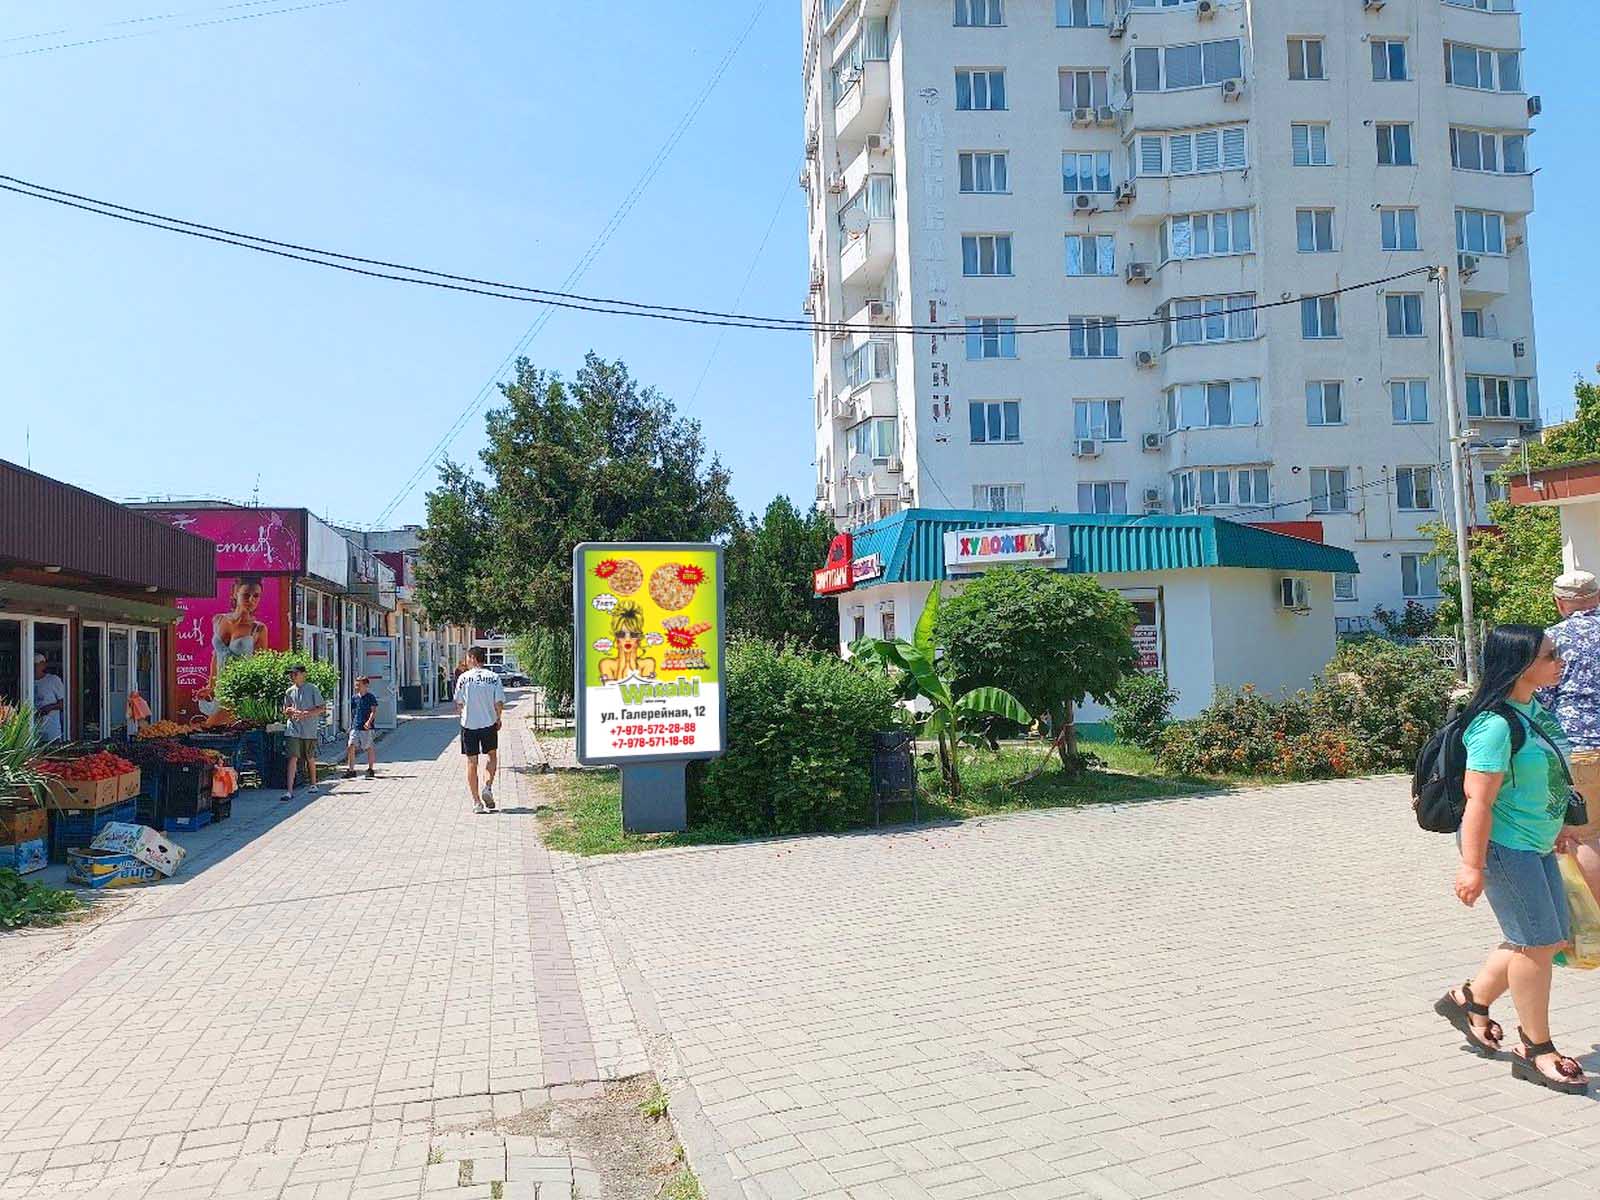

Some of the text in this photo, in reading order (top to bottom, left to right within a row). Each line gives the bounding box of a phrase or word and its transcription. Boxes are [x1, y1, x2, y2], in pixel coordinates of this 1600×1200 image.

[960, 534, 1046, 557] ХУДОЖНИК
[601, 706, 706, 723] ул. Галерейная, 12
[610, 723, 696, 736] +7-978-572-28-88
[612, 735, 695, 748] +7-978-571-18-88
